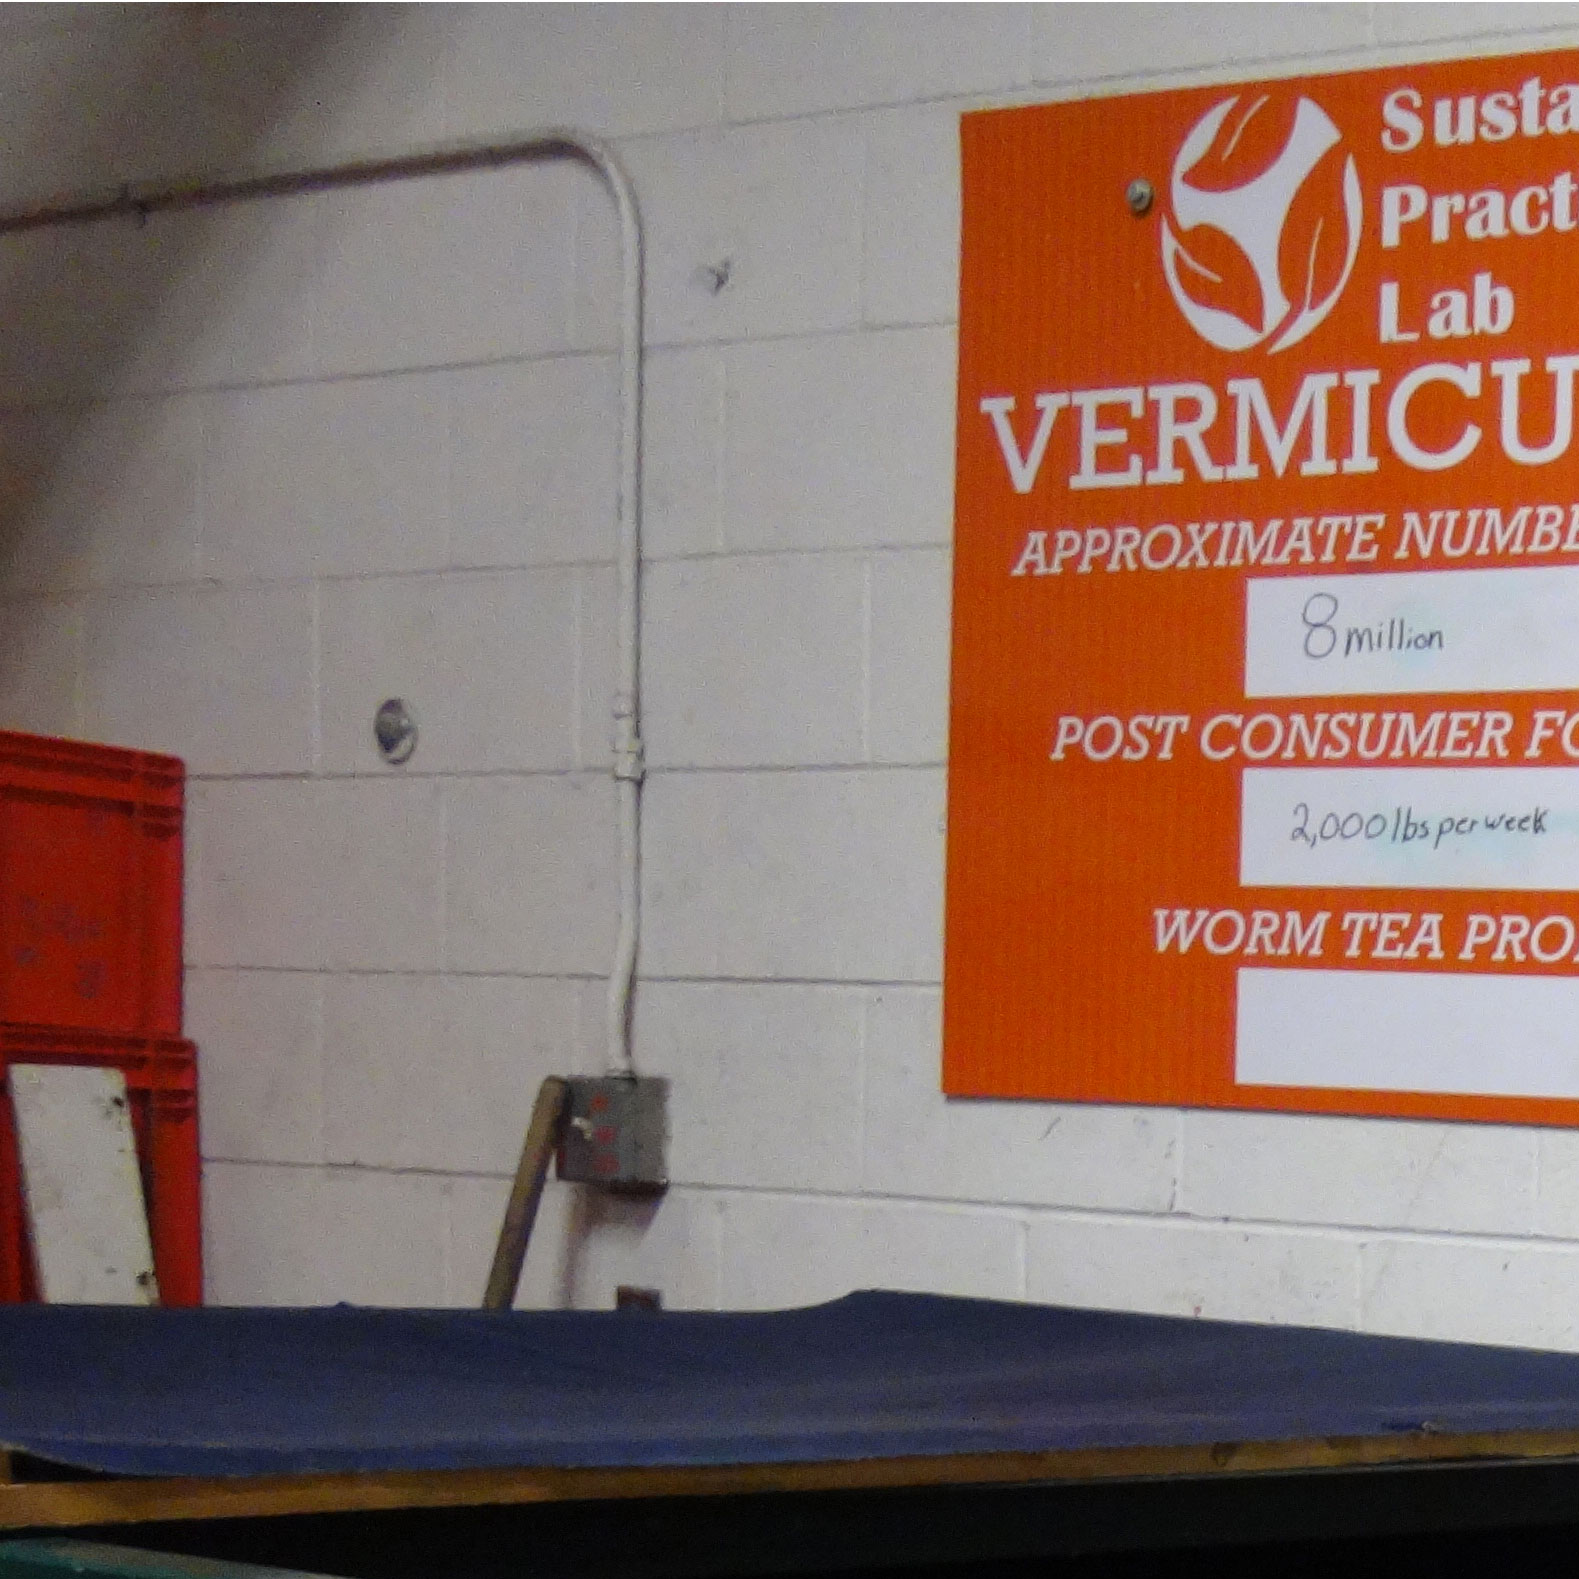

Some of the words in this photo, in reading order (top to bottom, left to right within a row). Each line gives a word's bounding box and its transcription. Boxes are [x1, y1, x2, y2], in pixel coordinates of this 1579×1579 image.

[1378, 271, 1515, 343] Lab
[1011, 511, 1386, 576] APPROXIMATE
[1301, 592, 1338, 659] 8
[1344, 617, 1444, 657] million
[1050, 714, 1191, 760] POST
[1200, 710, 1515, 761] CONSUMER
[1434, 815, 1479, 850] per
[1484, 807, 1548, 834] week
[1153, 907, 1332, 957] WORM
[1341, 910, 1444, 959] TEA
